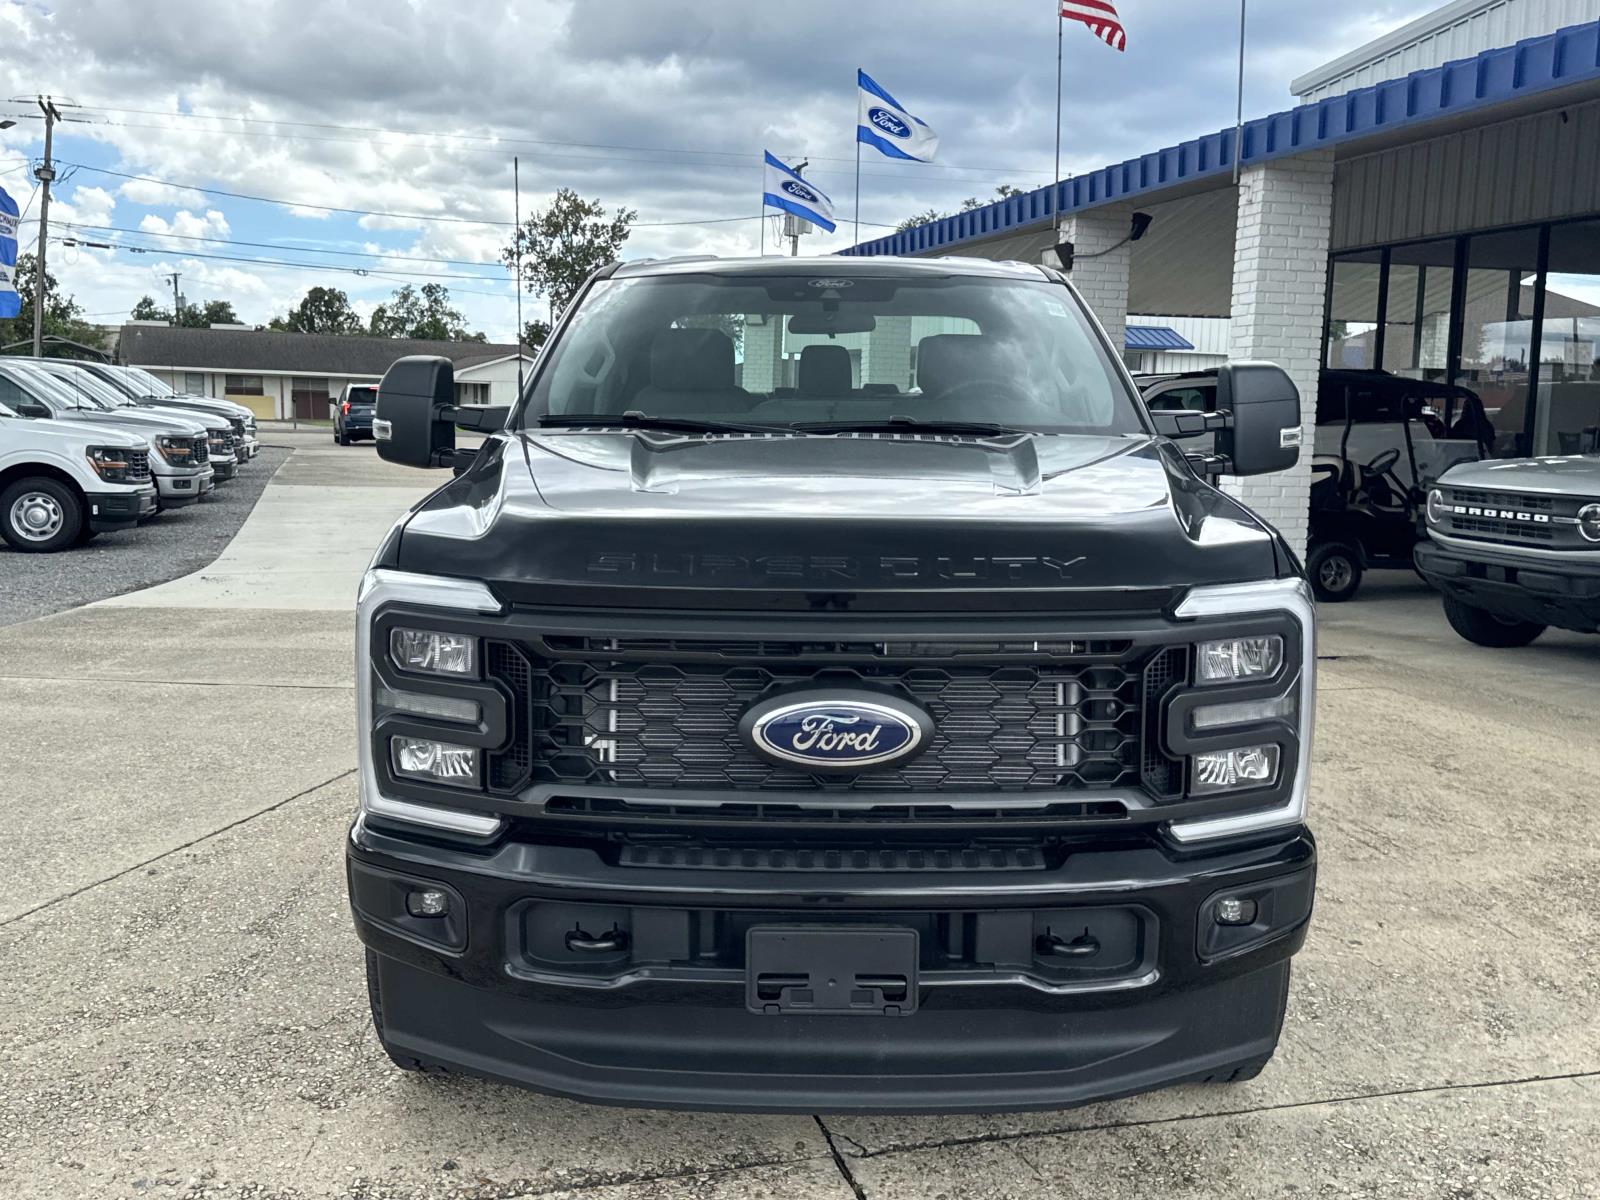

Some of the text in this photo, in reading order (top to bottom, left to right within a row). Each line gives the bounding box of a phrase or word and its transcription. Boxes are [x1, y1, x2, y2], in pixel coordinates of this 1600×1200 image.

[873, 111, 905, 134] Ford
[787, 182, 813, 200] Ford
[1454, 505, 1549, 522] BRONCO
[587, 553, 1087, 579] SUPER DUTY
[792, 714, 882, 751] Ford
